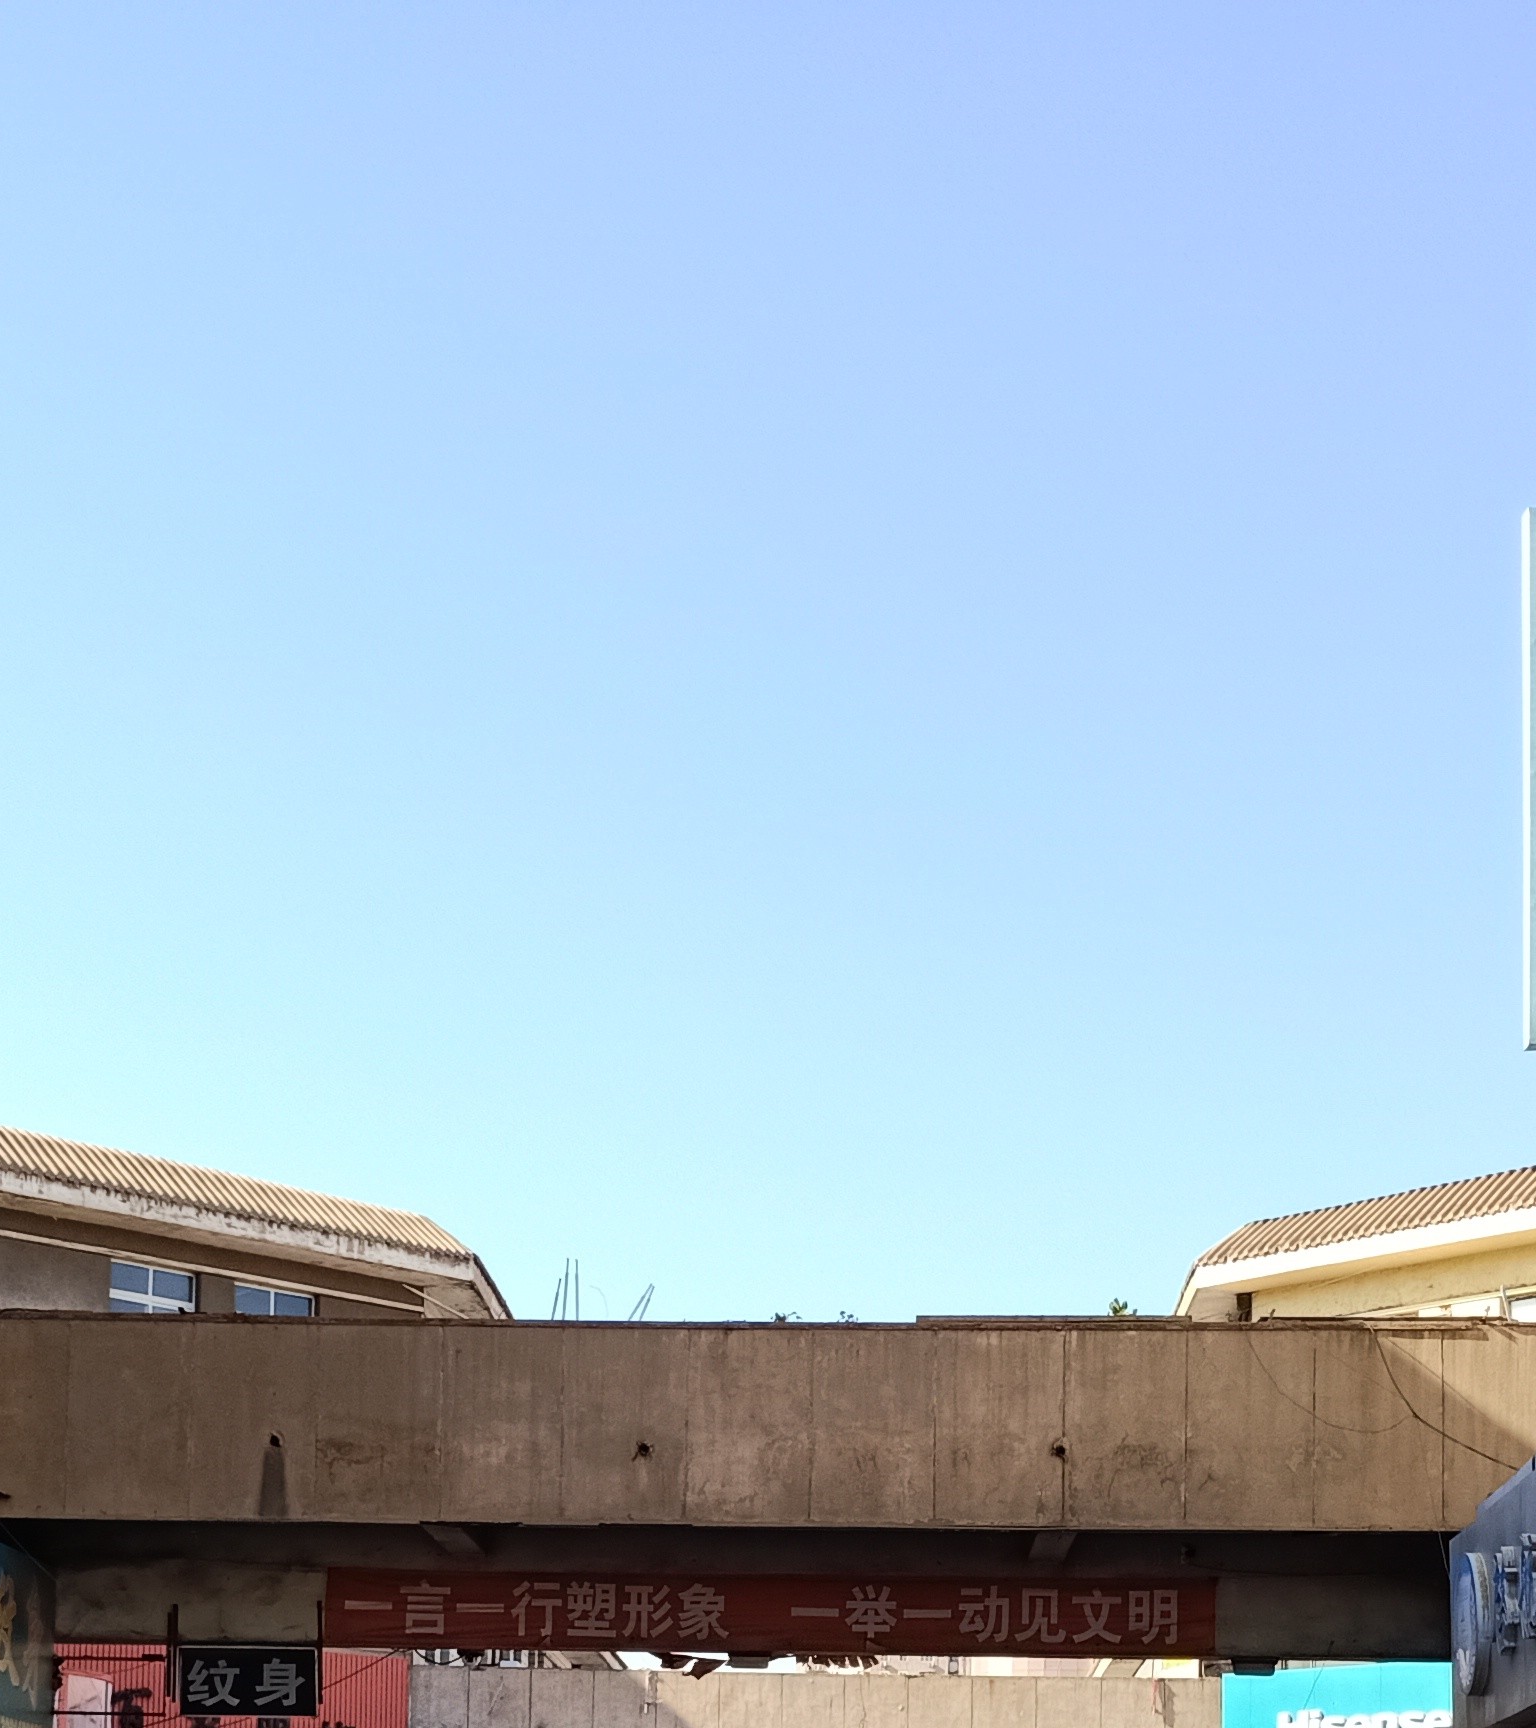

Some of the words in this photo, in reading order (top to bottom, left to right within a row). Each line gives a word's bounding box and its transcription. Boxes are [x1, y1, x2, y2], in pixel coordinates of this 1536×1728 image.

[343, 1581, 731, 1642] 一言一行塑形象
[790, 1585, 1179, 1645] 一举一动见文明
[186, 1657, 306, 1707] 纹身
